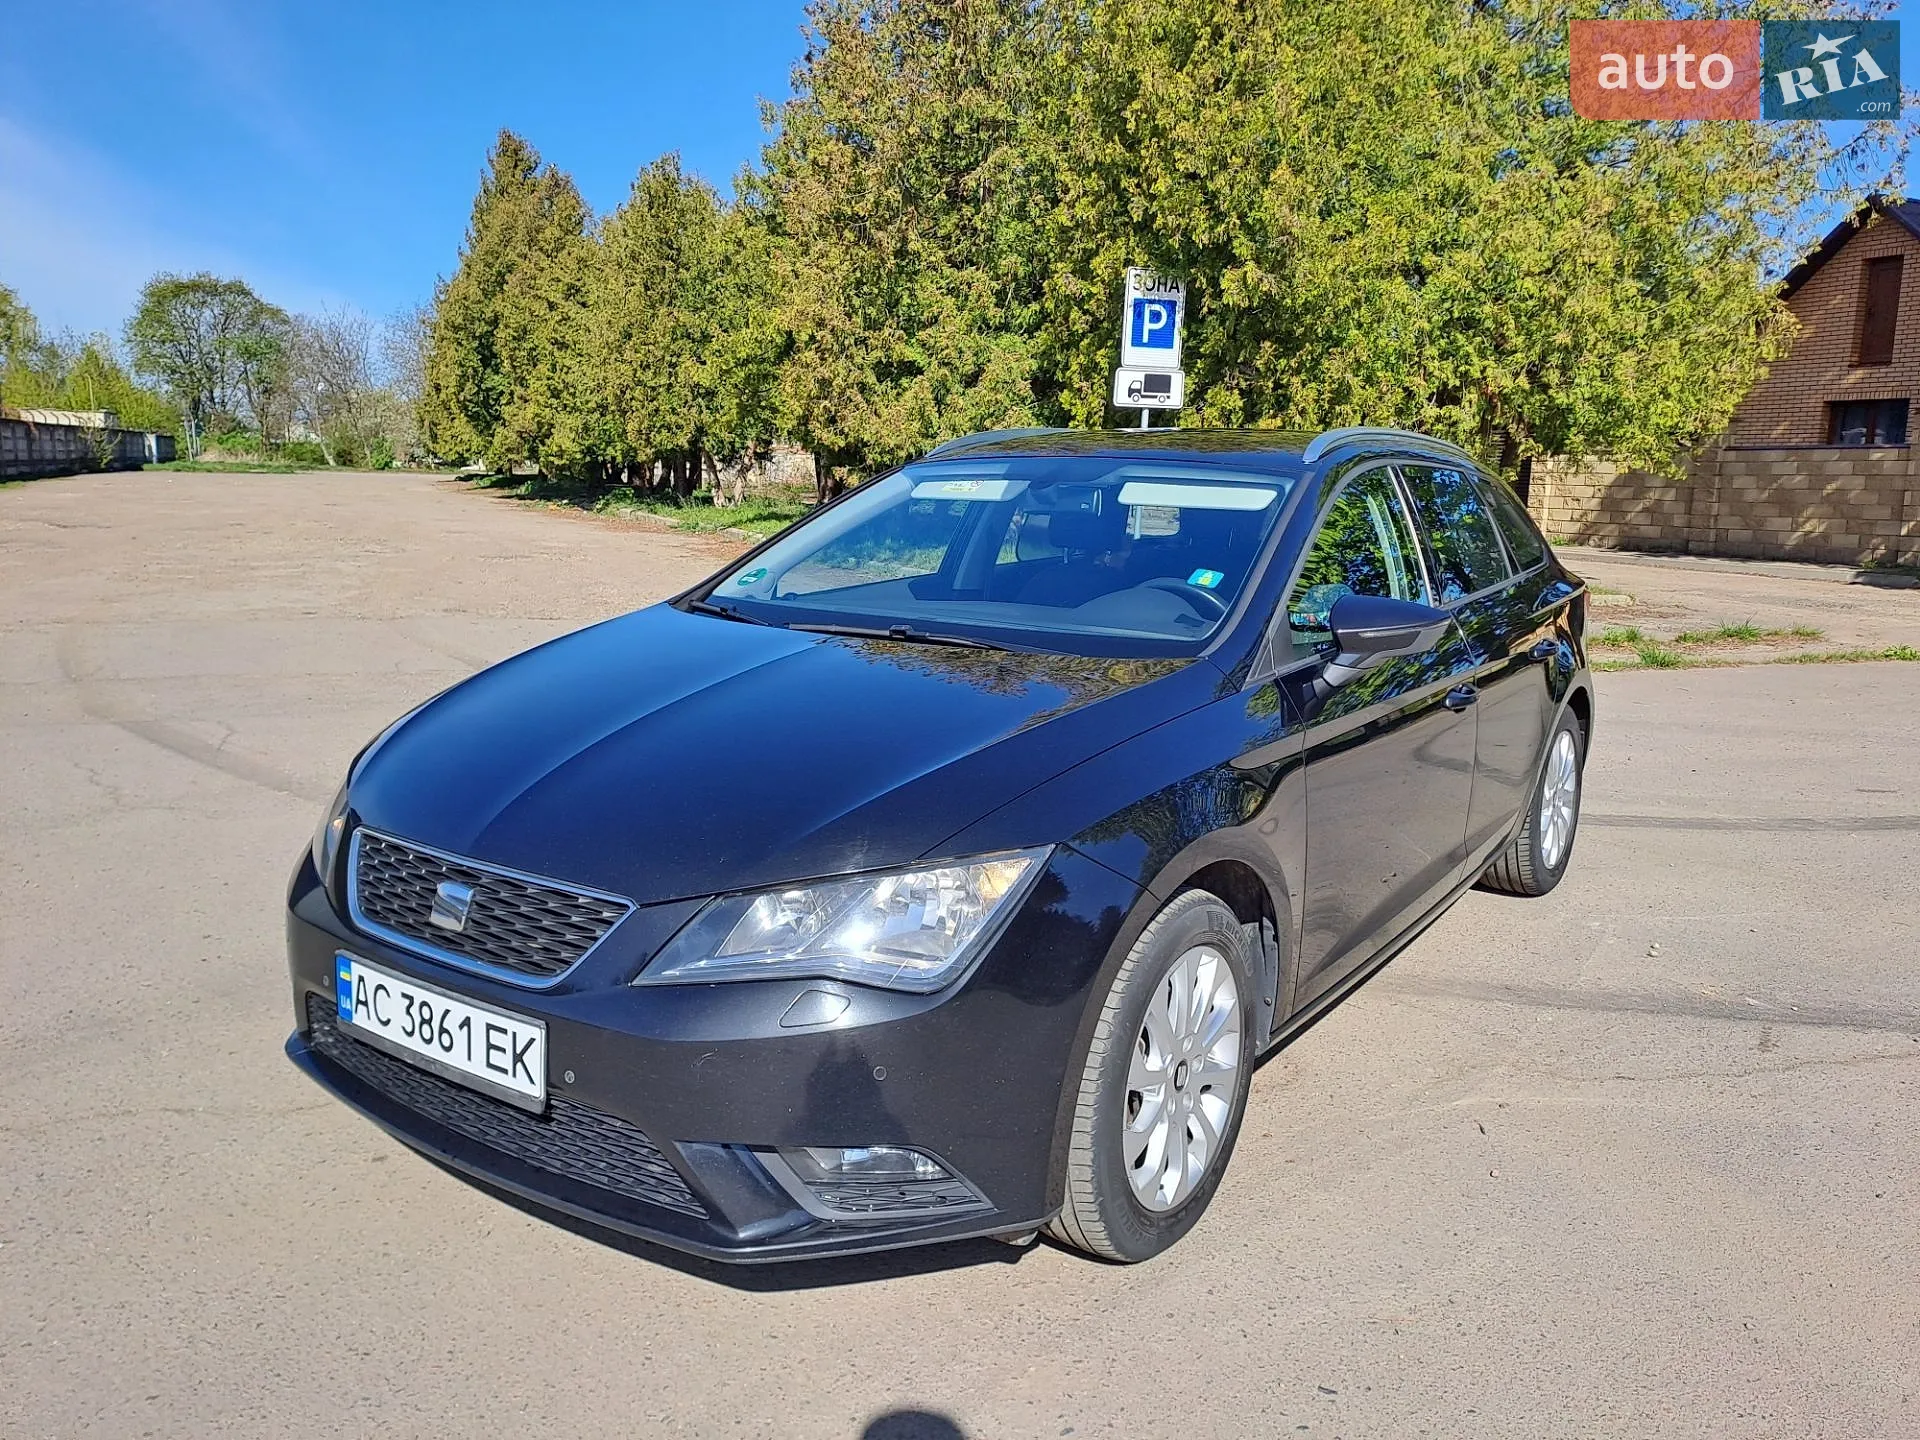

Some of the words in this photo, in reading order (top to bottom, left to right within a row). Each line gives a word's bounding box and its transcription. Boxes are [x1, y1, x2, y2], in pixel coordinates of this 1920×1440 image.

[1142, 303, 1168, 344] P
[355, 974, 392, 1027] AC
[400, 991, 473, 1062] 3861
[485, 1022, 537, 1087] EK
